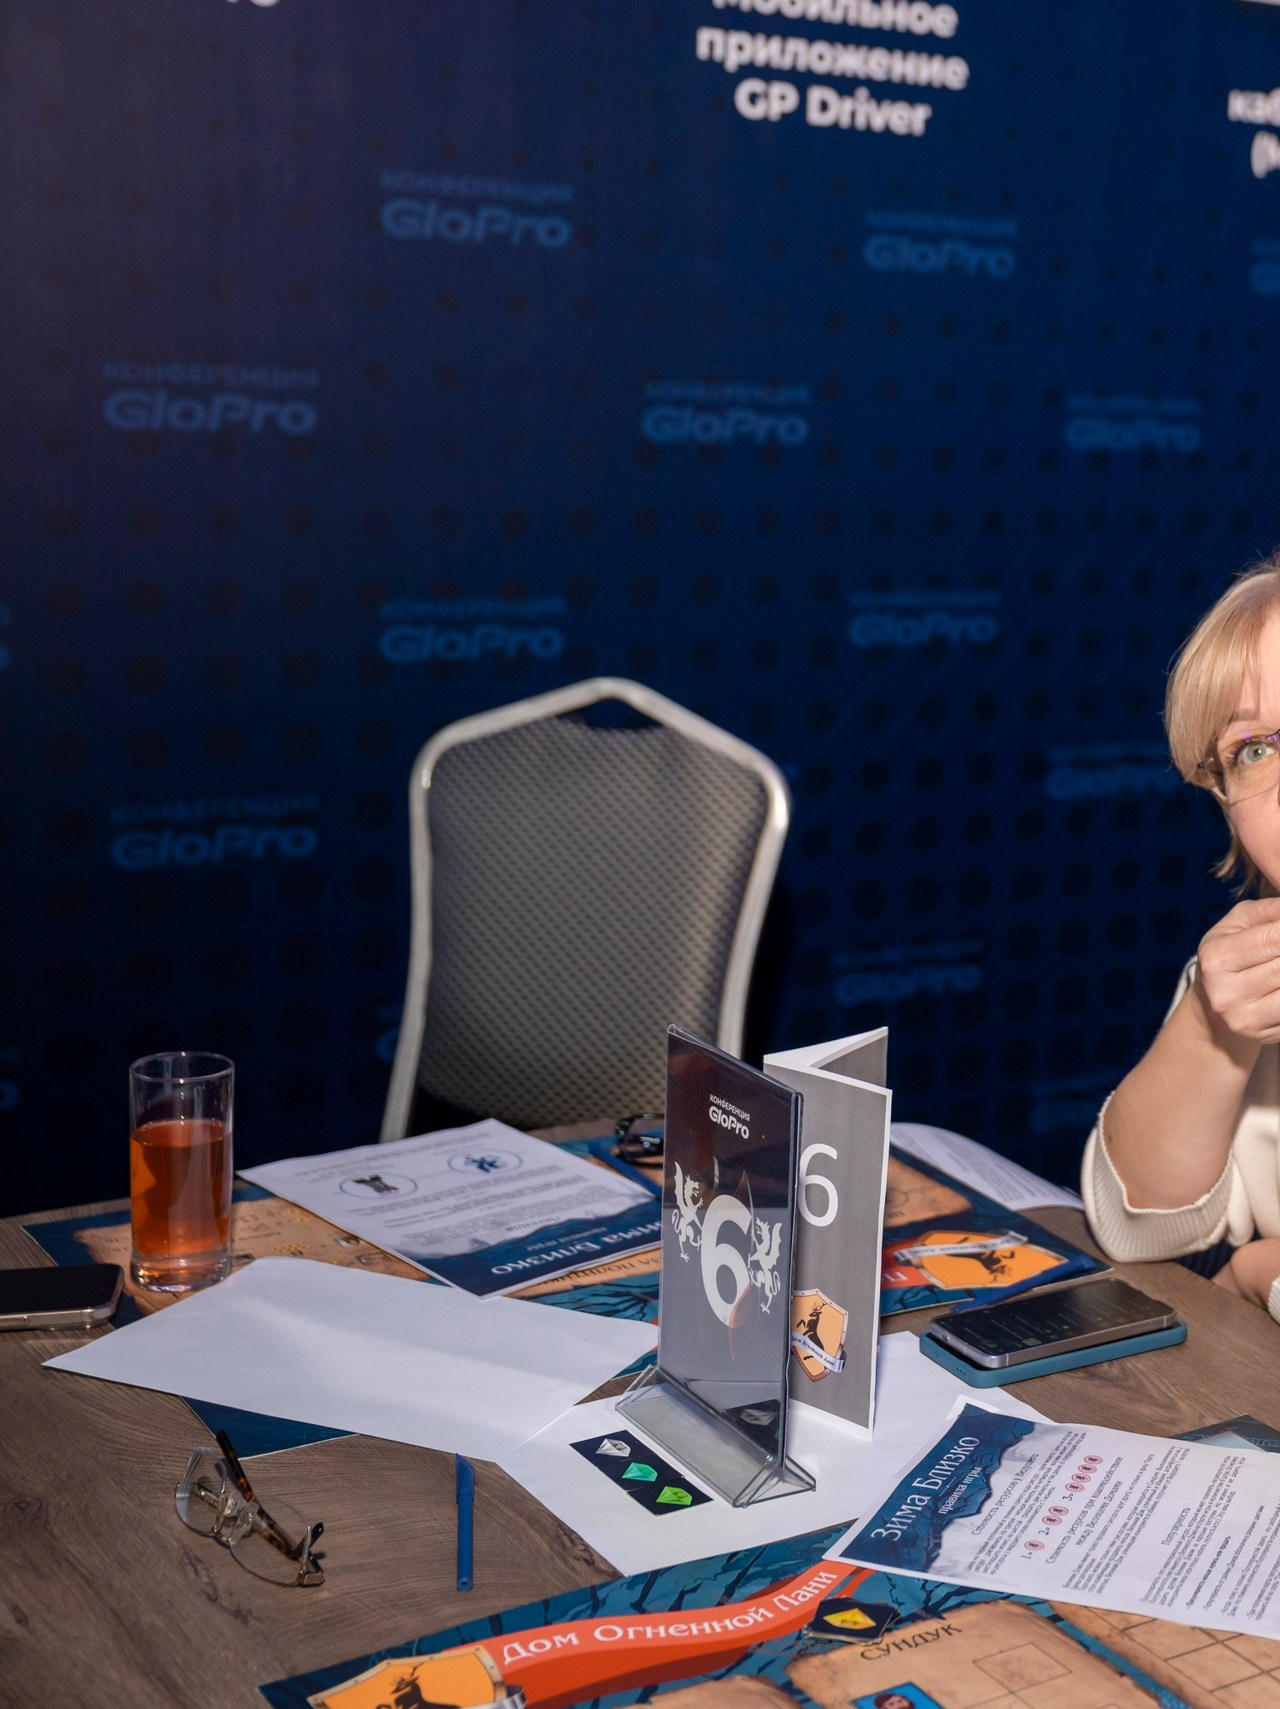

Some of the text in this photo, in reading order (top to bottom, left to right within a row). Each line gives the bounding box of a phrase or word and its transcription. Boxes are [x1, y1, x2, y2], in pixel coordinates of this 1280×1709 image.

[696, 26, 970, 90] приложение
[734, 78, 933, 137] GP Driver
[381, 200, 572, 248] GloPro
[864, 235, 1016, 279] GloPro
[103, 390, 317, 434] GloPro
[642, 405, 808, 445] GloPro
[379, 626, 566, 662] GloPro
[849, 612, 998, 648] GloPro
[110, 825, 319, 870] GloPro
[709, 1105, 749, 1139] GloPro
[710, 1093, 750, 1122] КОНФЕРЕНЦИЯ
[797, 1143, 839, 1227] 6
[491, 1242, 602, 1274] Близко
[700, 1194, 752, 1327] 6
[871, 1436, 980, 1542] Зима Близко
[936, 1466, 985, 1514] правила игры
[501, 1570, 838, 1668] Дом Огненной Лани
[860, 1622, 963, 1662] СУНДУК
